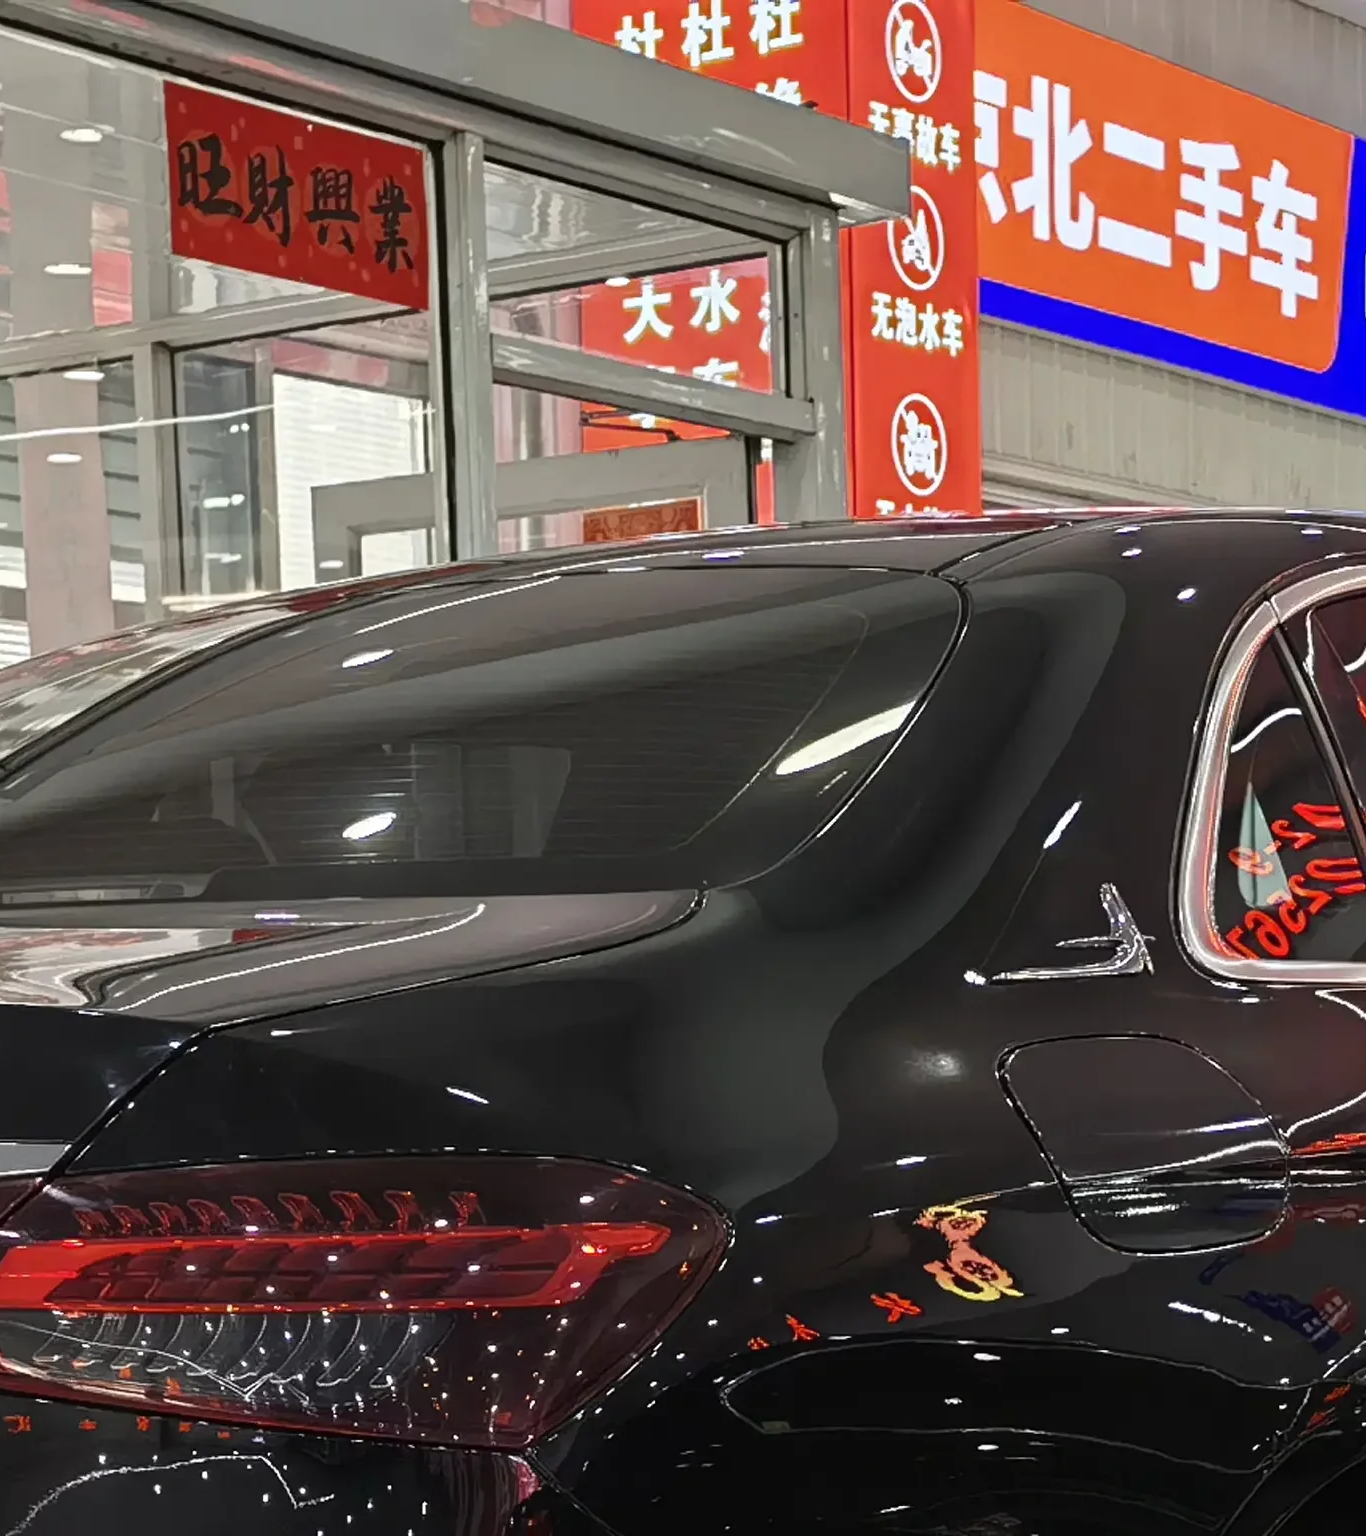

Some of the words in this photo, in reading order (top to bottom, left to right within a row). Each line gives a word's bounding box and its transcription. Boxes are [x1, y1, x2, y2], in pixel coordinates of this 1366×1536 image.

[175, 133, 417, 275] 旺財興業
[869, 291, 965, 358] 无泡水车
